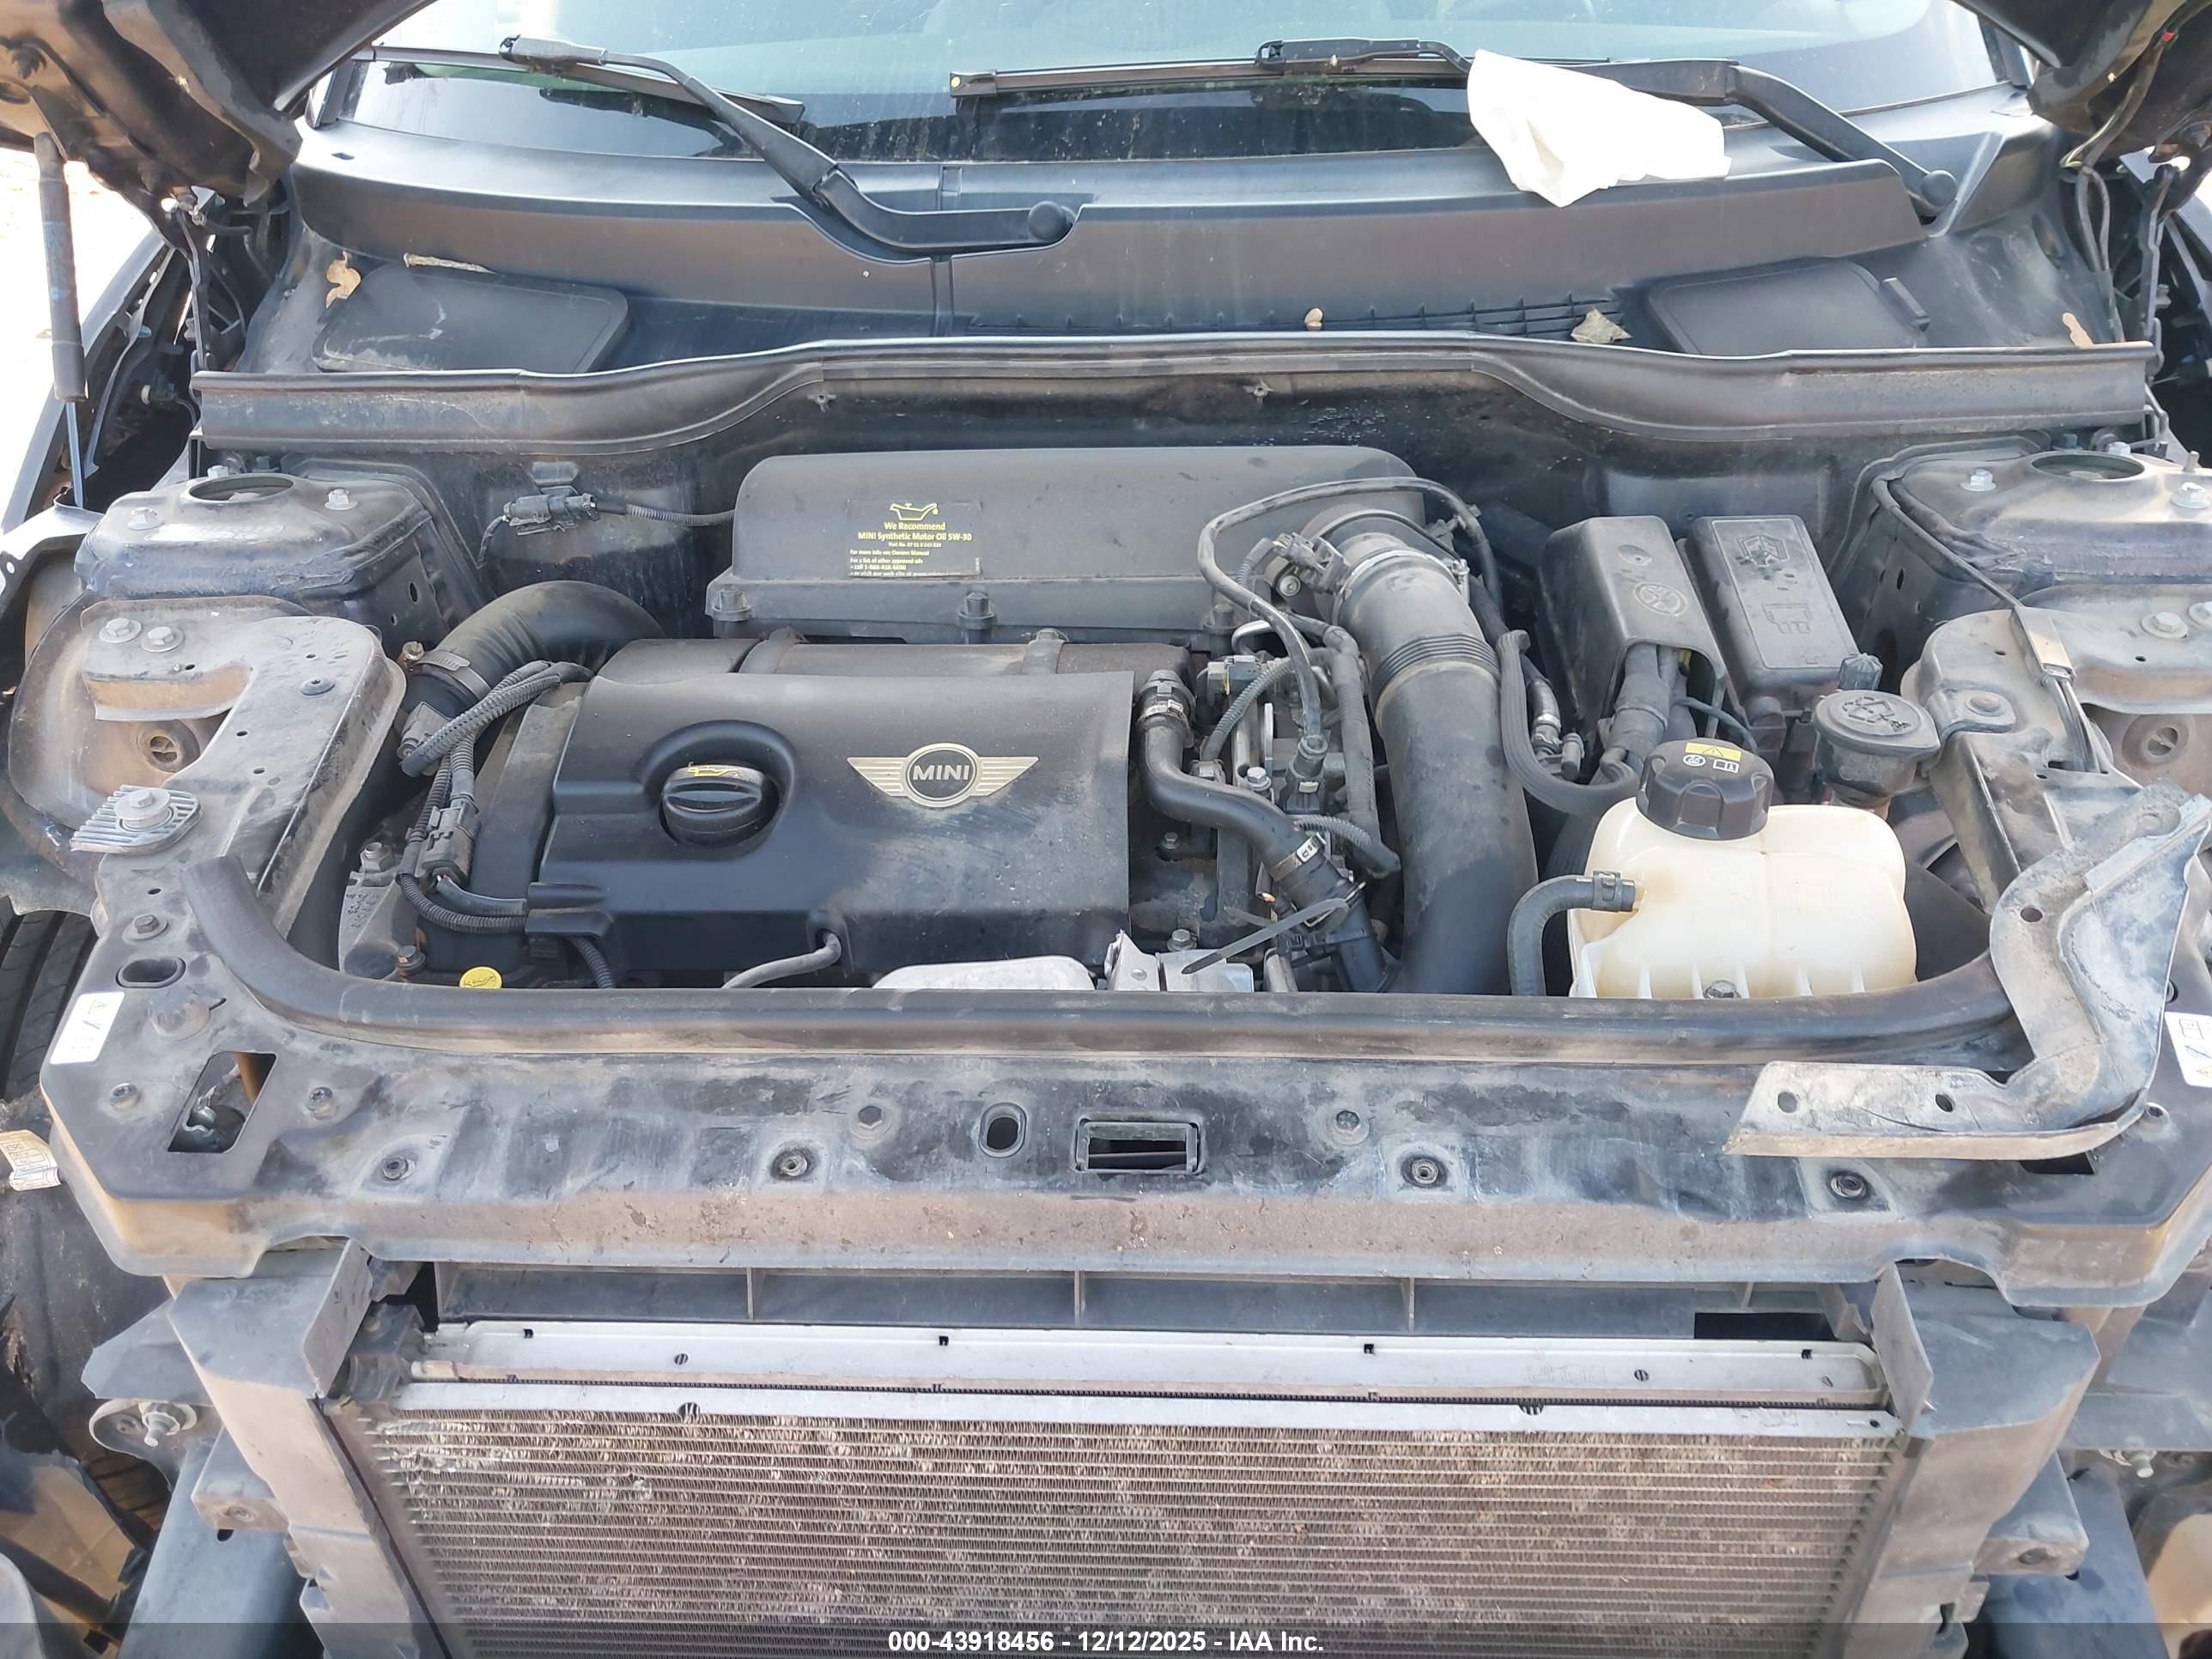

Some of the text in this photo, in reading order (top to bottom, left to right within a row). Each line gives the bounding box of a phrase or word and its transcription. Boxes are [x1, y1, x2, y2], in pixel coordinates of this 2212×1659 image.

[884, 522, 945, 531] We Recommend
[878, 532, 911, 542] Synthetic
[912, 763, 970, 781] MINI
